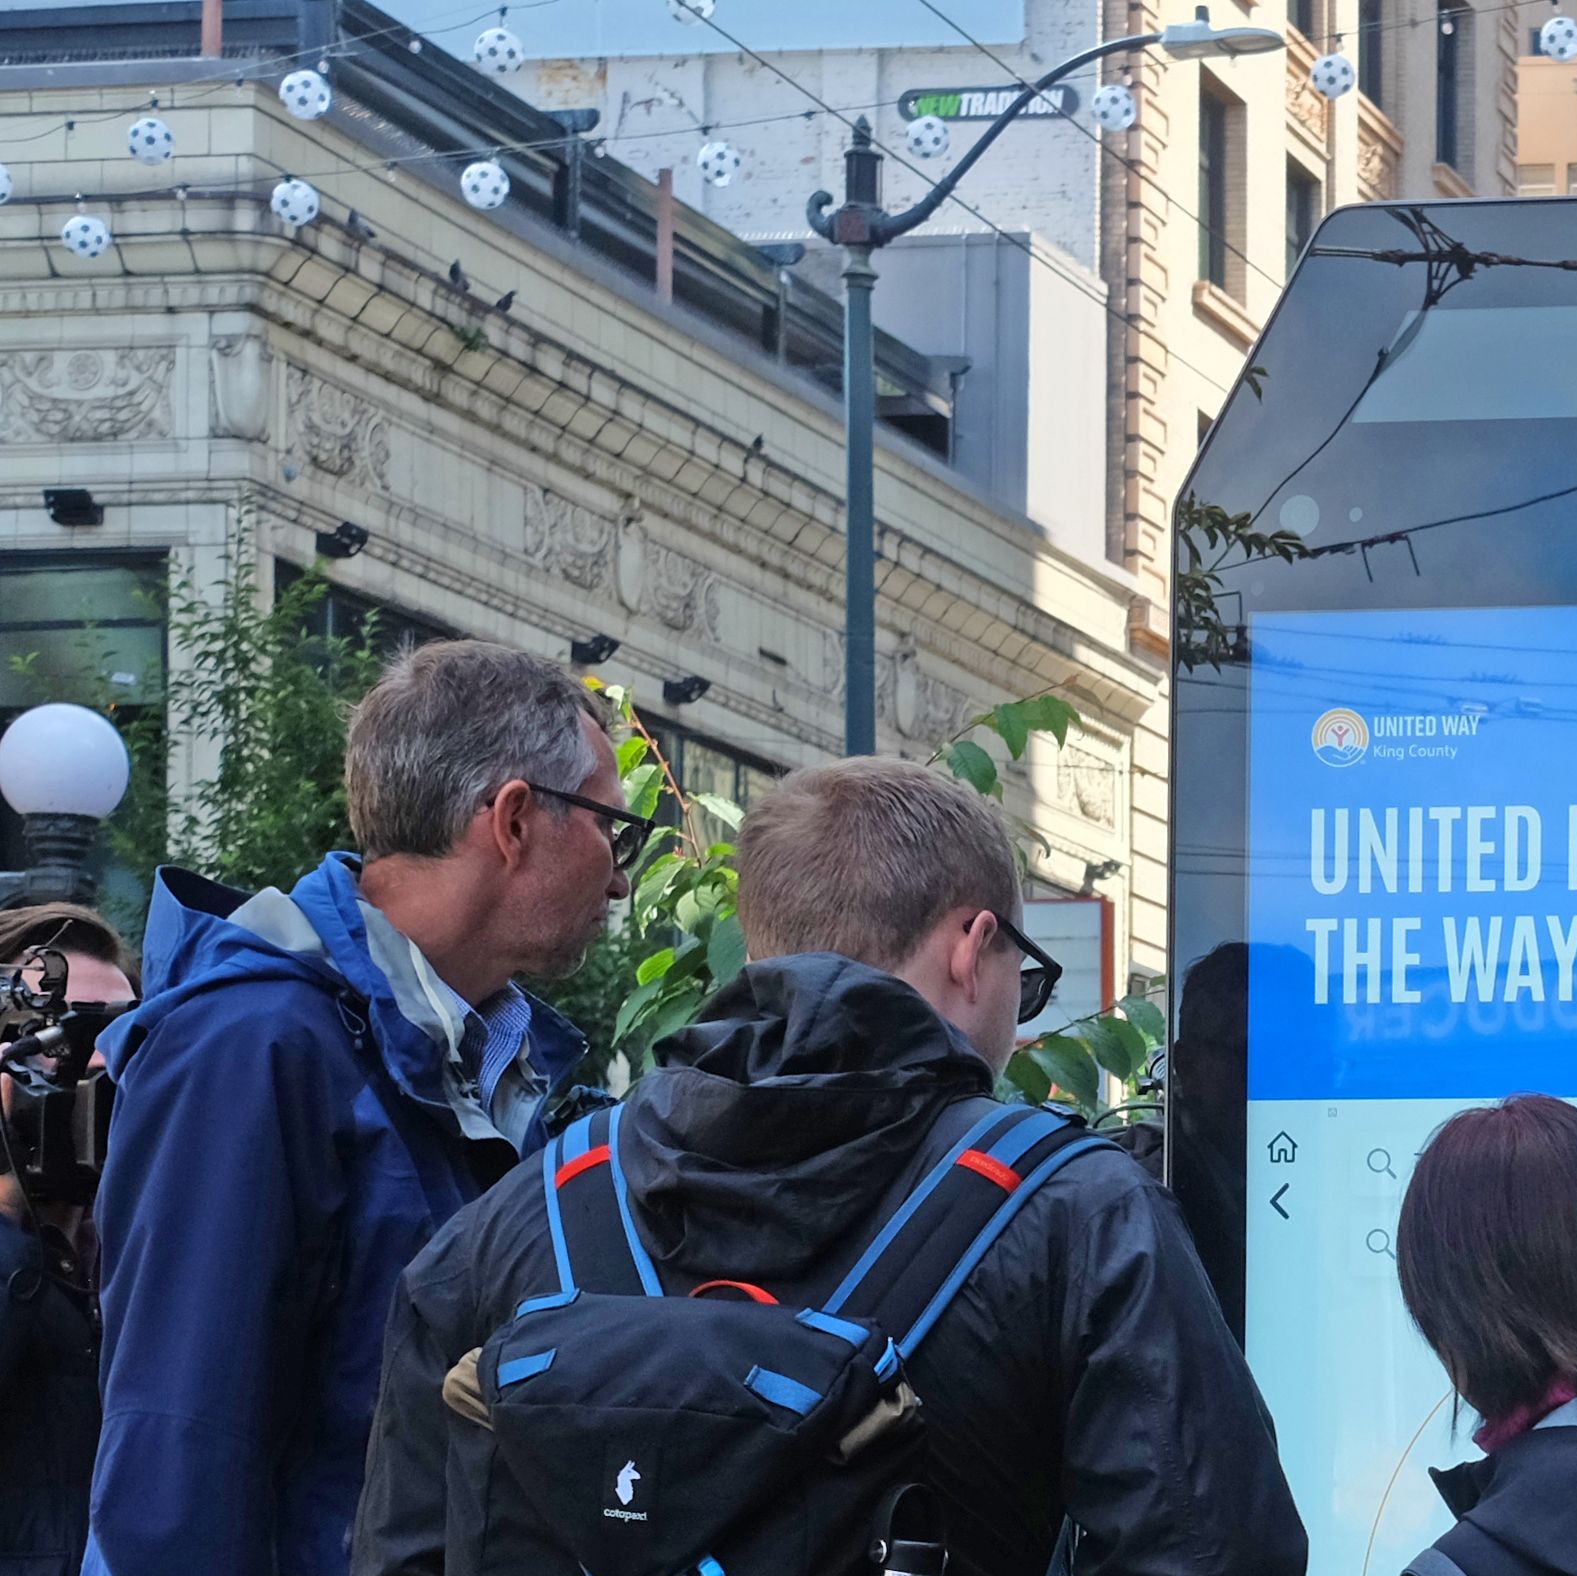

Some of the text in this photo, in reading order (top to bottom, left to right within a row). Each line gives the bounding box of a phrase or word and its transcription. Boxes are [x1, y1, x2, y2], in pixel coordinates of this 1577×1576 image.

[1373, 714, 1481, 737] UNITED WAY
[1373, 744, 1458, 760] King County
[1311, 805, 1543, 895] UNITED
[1305, 917, 1422, 1005] THE
[603, 1508, 648, 1523] cotopaxi
